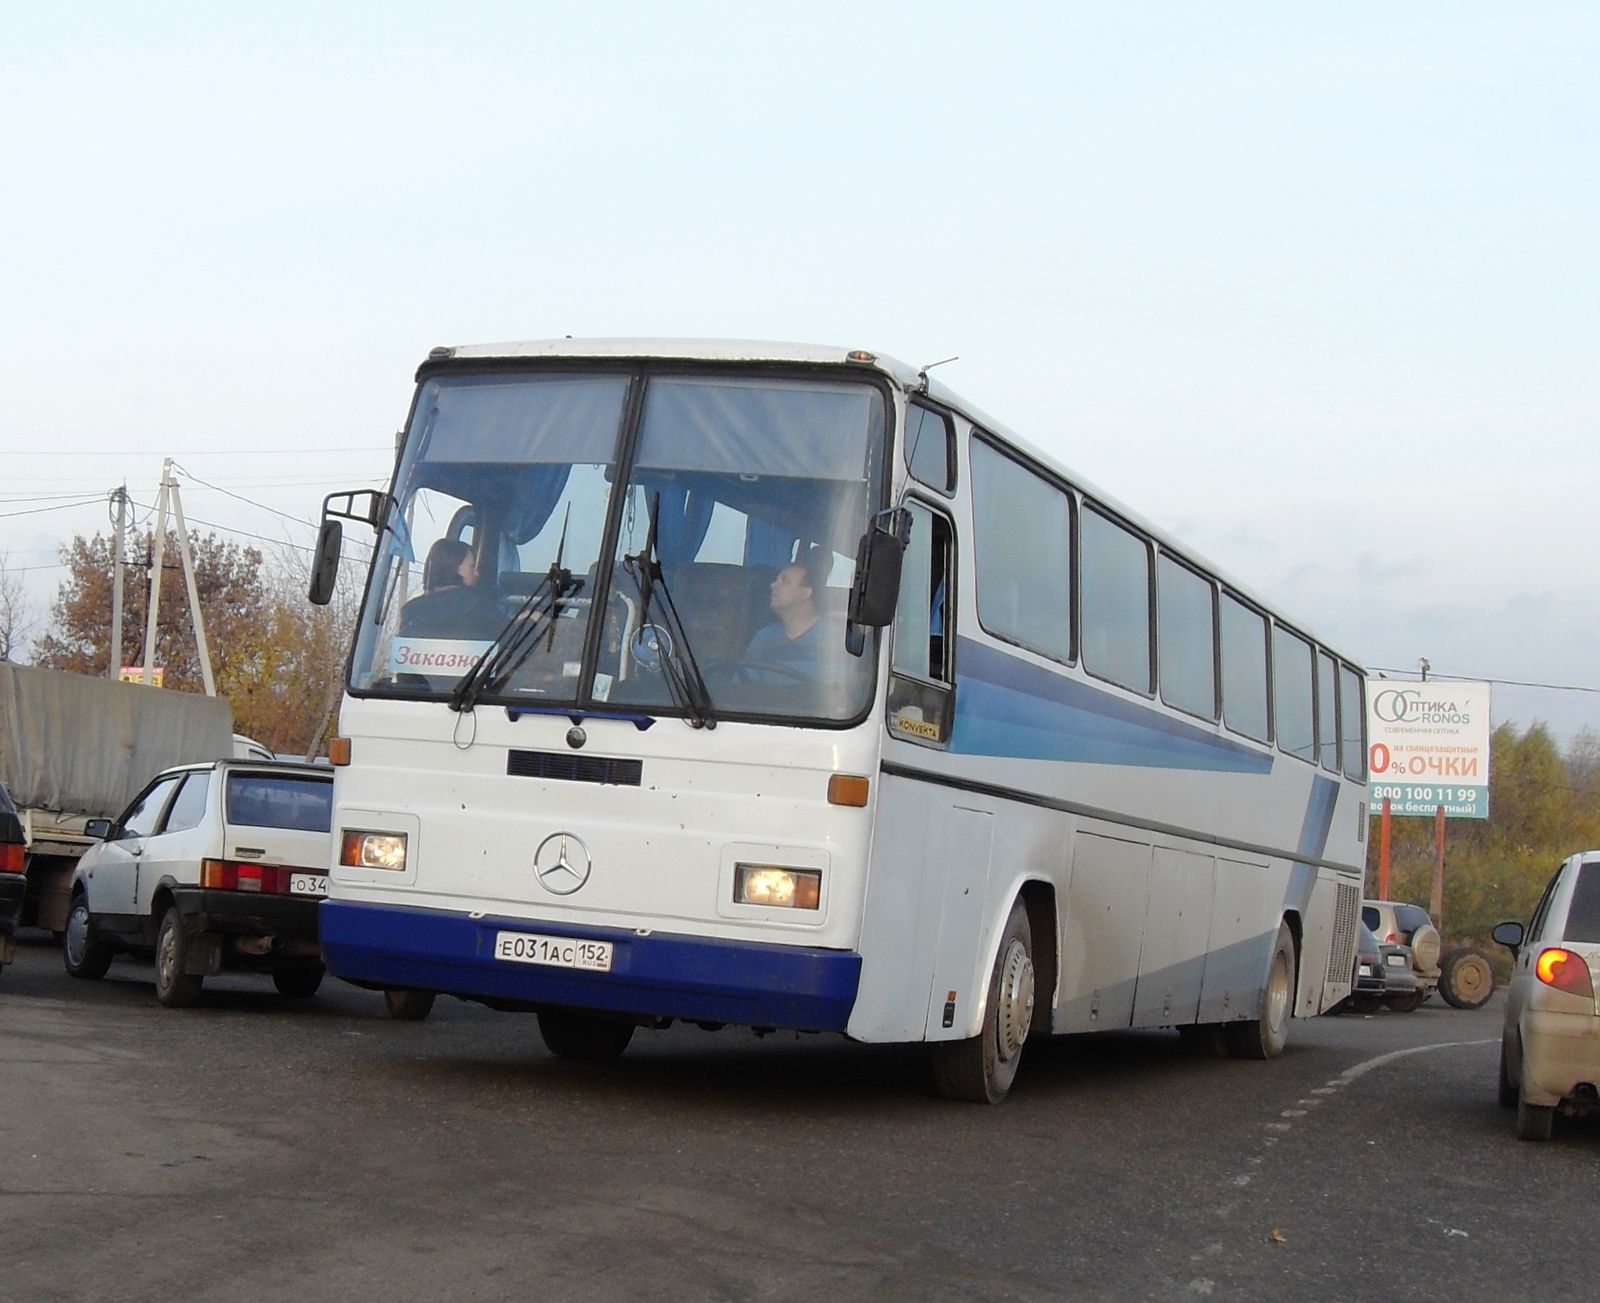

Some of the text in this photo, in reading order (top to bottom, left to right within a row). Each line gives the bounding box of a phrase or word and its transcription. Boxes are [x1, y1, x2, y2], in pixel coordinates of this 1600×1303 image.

[395, 645, 494, 669] Заказно
[898, 720, 937, 738] KONVEKTA
[1393, 744, 1404, 752] на
[1408, 756, 1478, 777] ОЧКИ
[1374, 786, 1476, 802] 800 100 11 99
[1405, 801, 1476, 814] бесплтный)
[578, 943, 606, 962] 152
